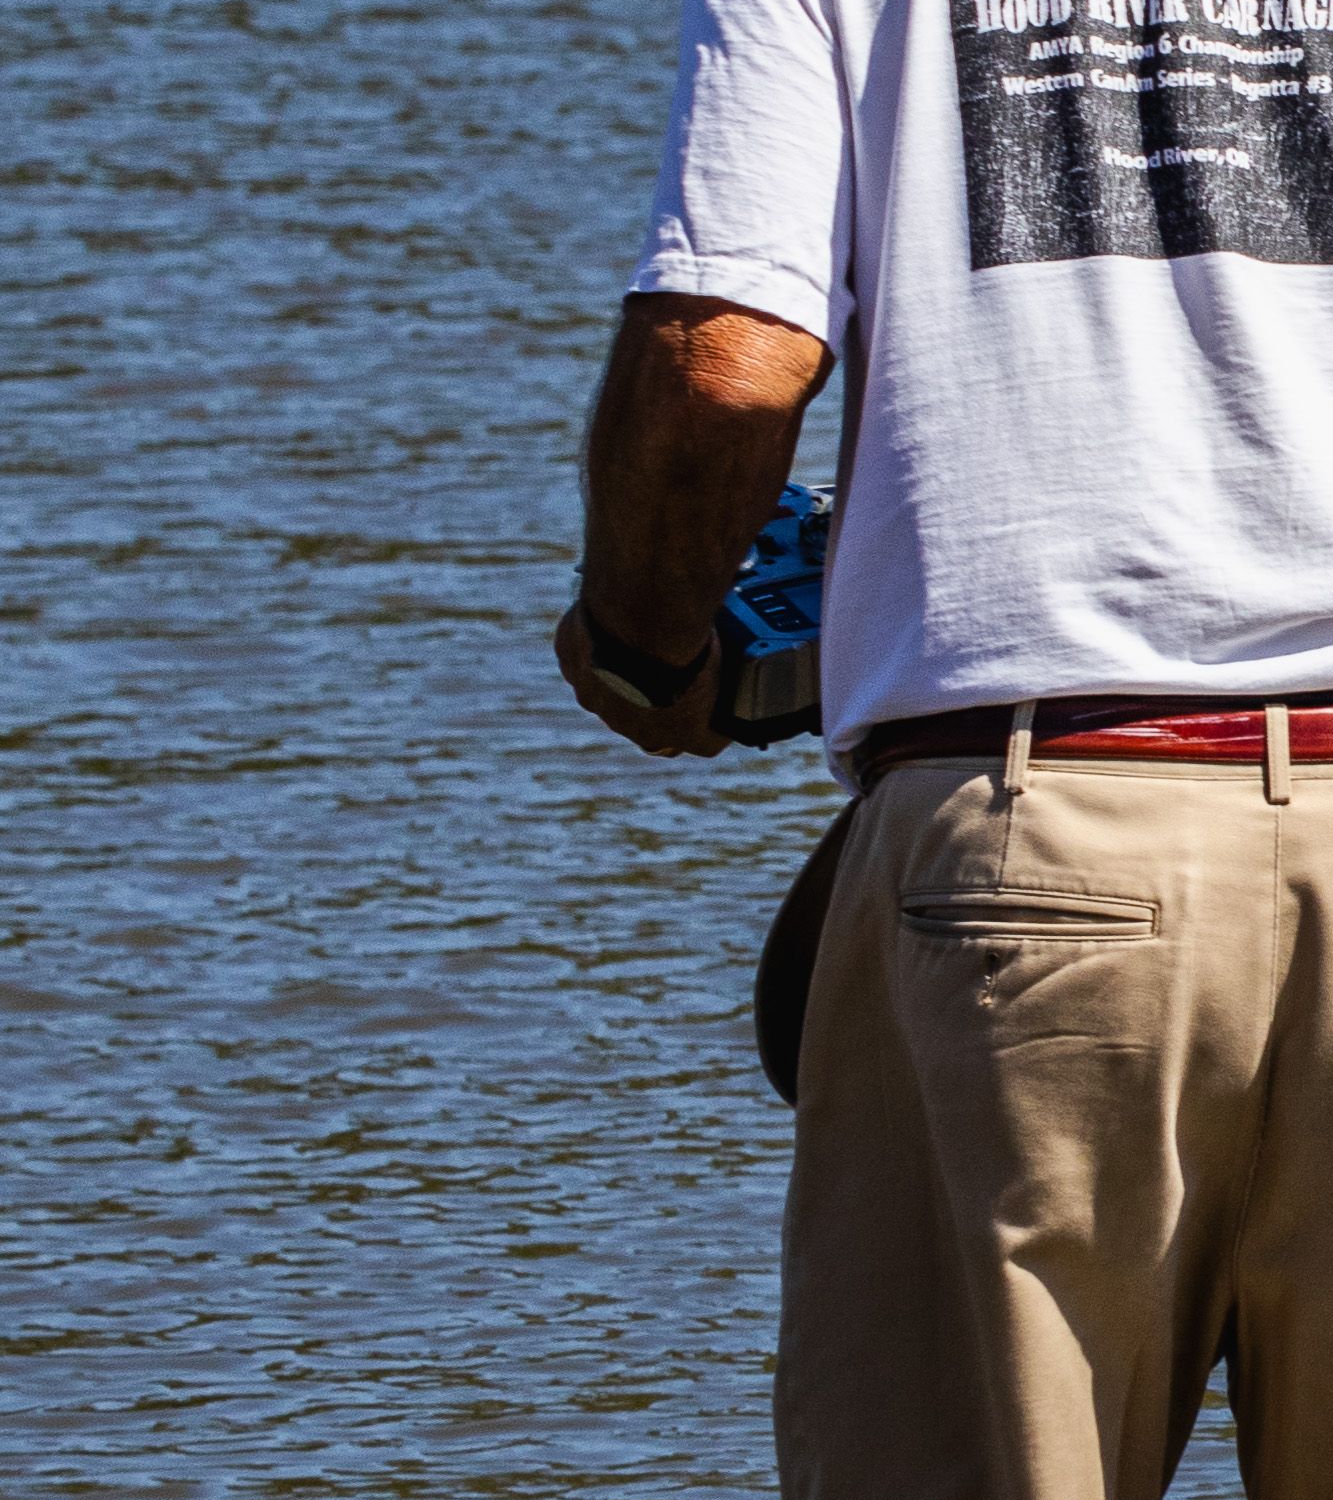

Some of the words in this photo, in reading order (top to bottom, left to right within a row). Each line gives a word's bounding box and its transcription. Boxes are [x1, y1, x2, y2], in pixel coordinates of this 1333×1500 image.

[1029, 35, 1084, 61] AMYA
[1090, 36, 1154, 64] Region
[1178, 35, 1304, 67] Championship
[1002, 73, 1084, 95] Western
[1157, 67, 1217, 88] Series
[1305, 74, 1333, 95] #3
[1102, 146, 1162, 169] Hood
